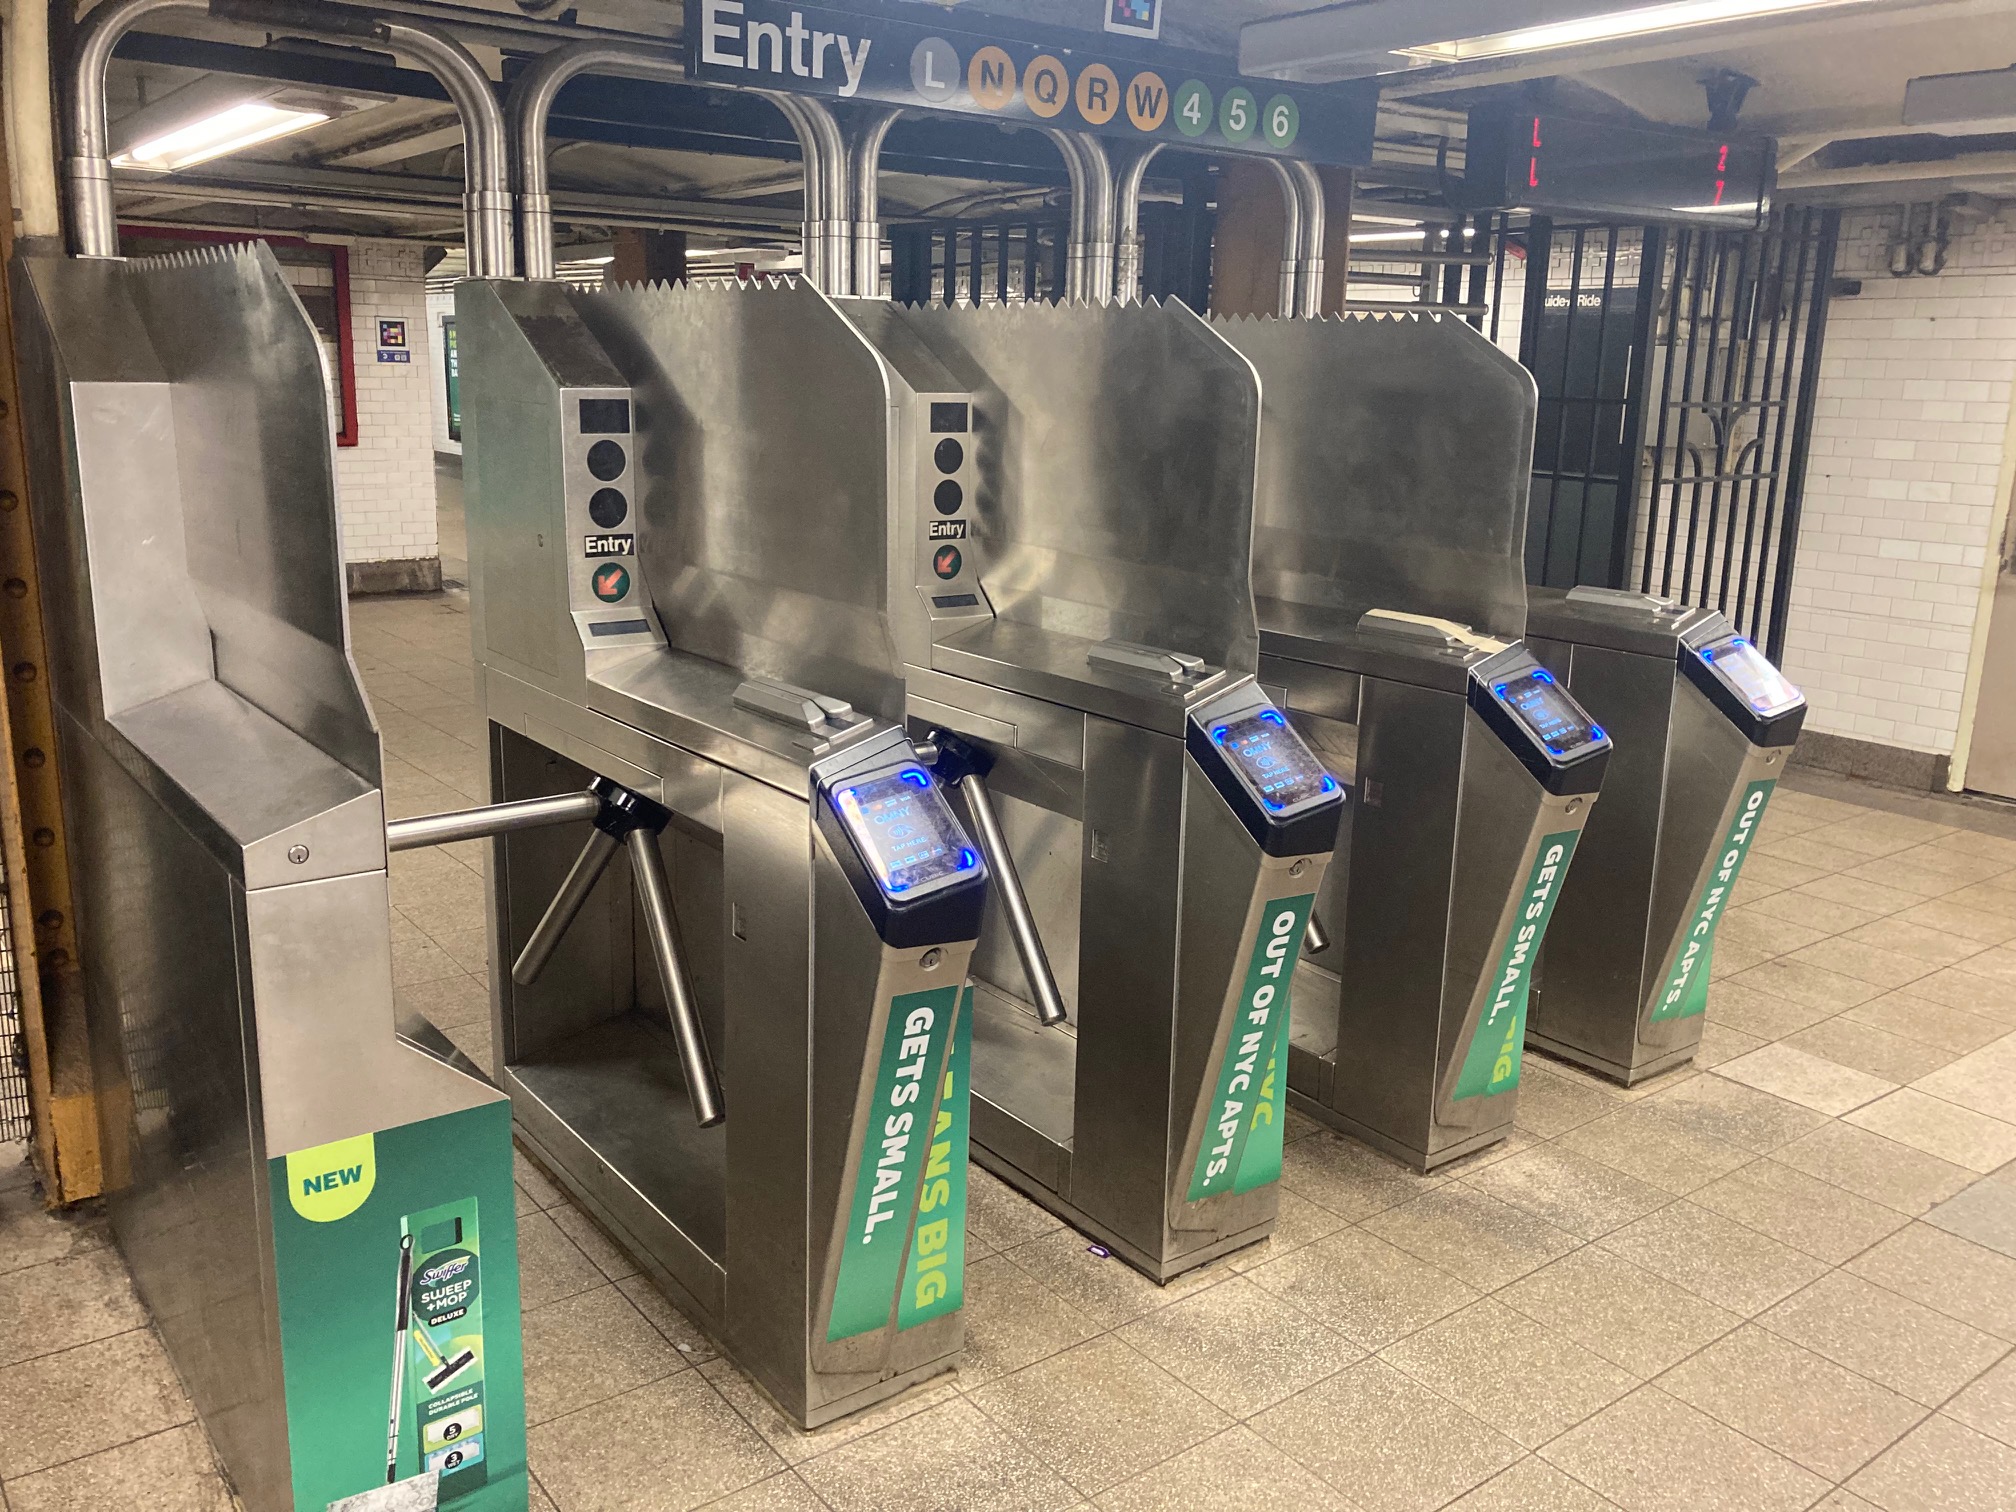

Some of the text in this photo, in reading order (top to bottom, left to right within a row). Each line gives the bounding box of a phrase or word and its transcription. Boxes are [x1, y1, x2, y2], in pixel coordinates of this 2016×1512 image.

[702, 0, 1290, 137] Entry L N Q R W 4 5 6
[930, 522, 964, 538] Entry
[585, 537, 632, 556] Entry
[1662, 790, 1764, 1011] OUT OF NYC APTS.
[1487, 844, 1563, 1026] GETS SMALL.
[1202, 910, 1295, 1187] OUT OF NYC APTS.
[862, 1007, 934, 1245] GETS SMALL.
[303, 1165, 362, 1196] NEW
[420, 1262, 469, 1285] Swiffer
[915, 1218, 949, 1310] BIG
[421, 1280, 472, 1303] SWEEP
[427, 1292, 467, 1311] +MOP
[431, 1309, 464, 1325] DELUXE
[428, 1388, 473, 1409] COLLAPSIBLE
[428, 1393, 478, 1415] DURABLE POLE
[449, 1425, 456, 1435] 5
[451, 1453, 458, 1462] 3
